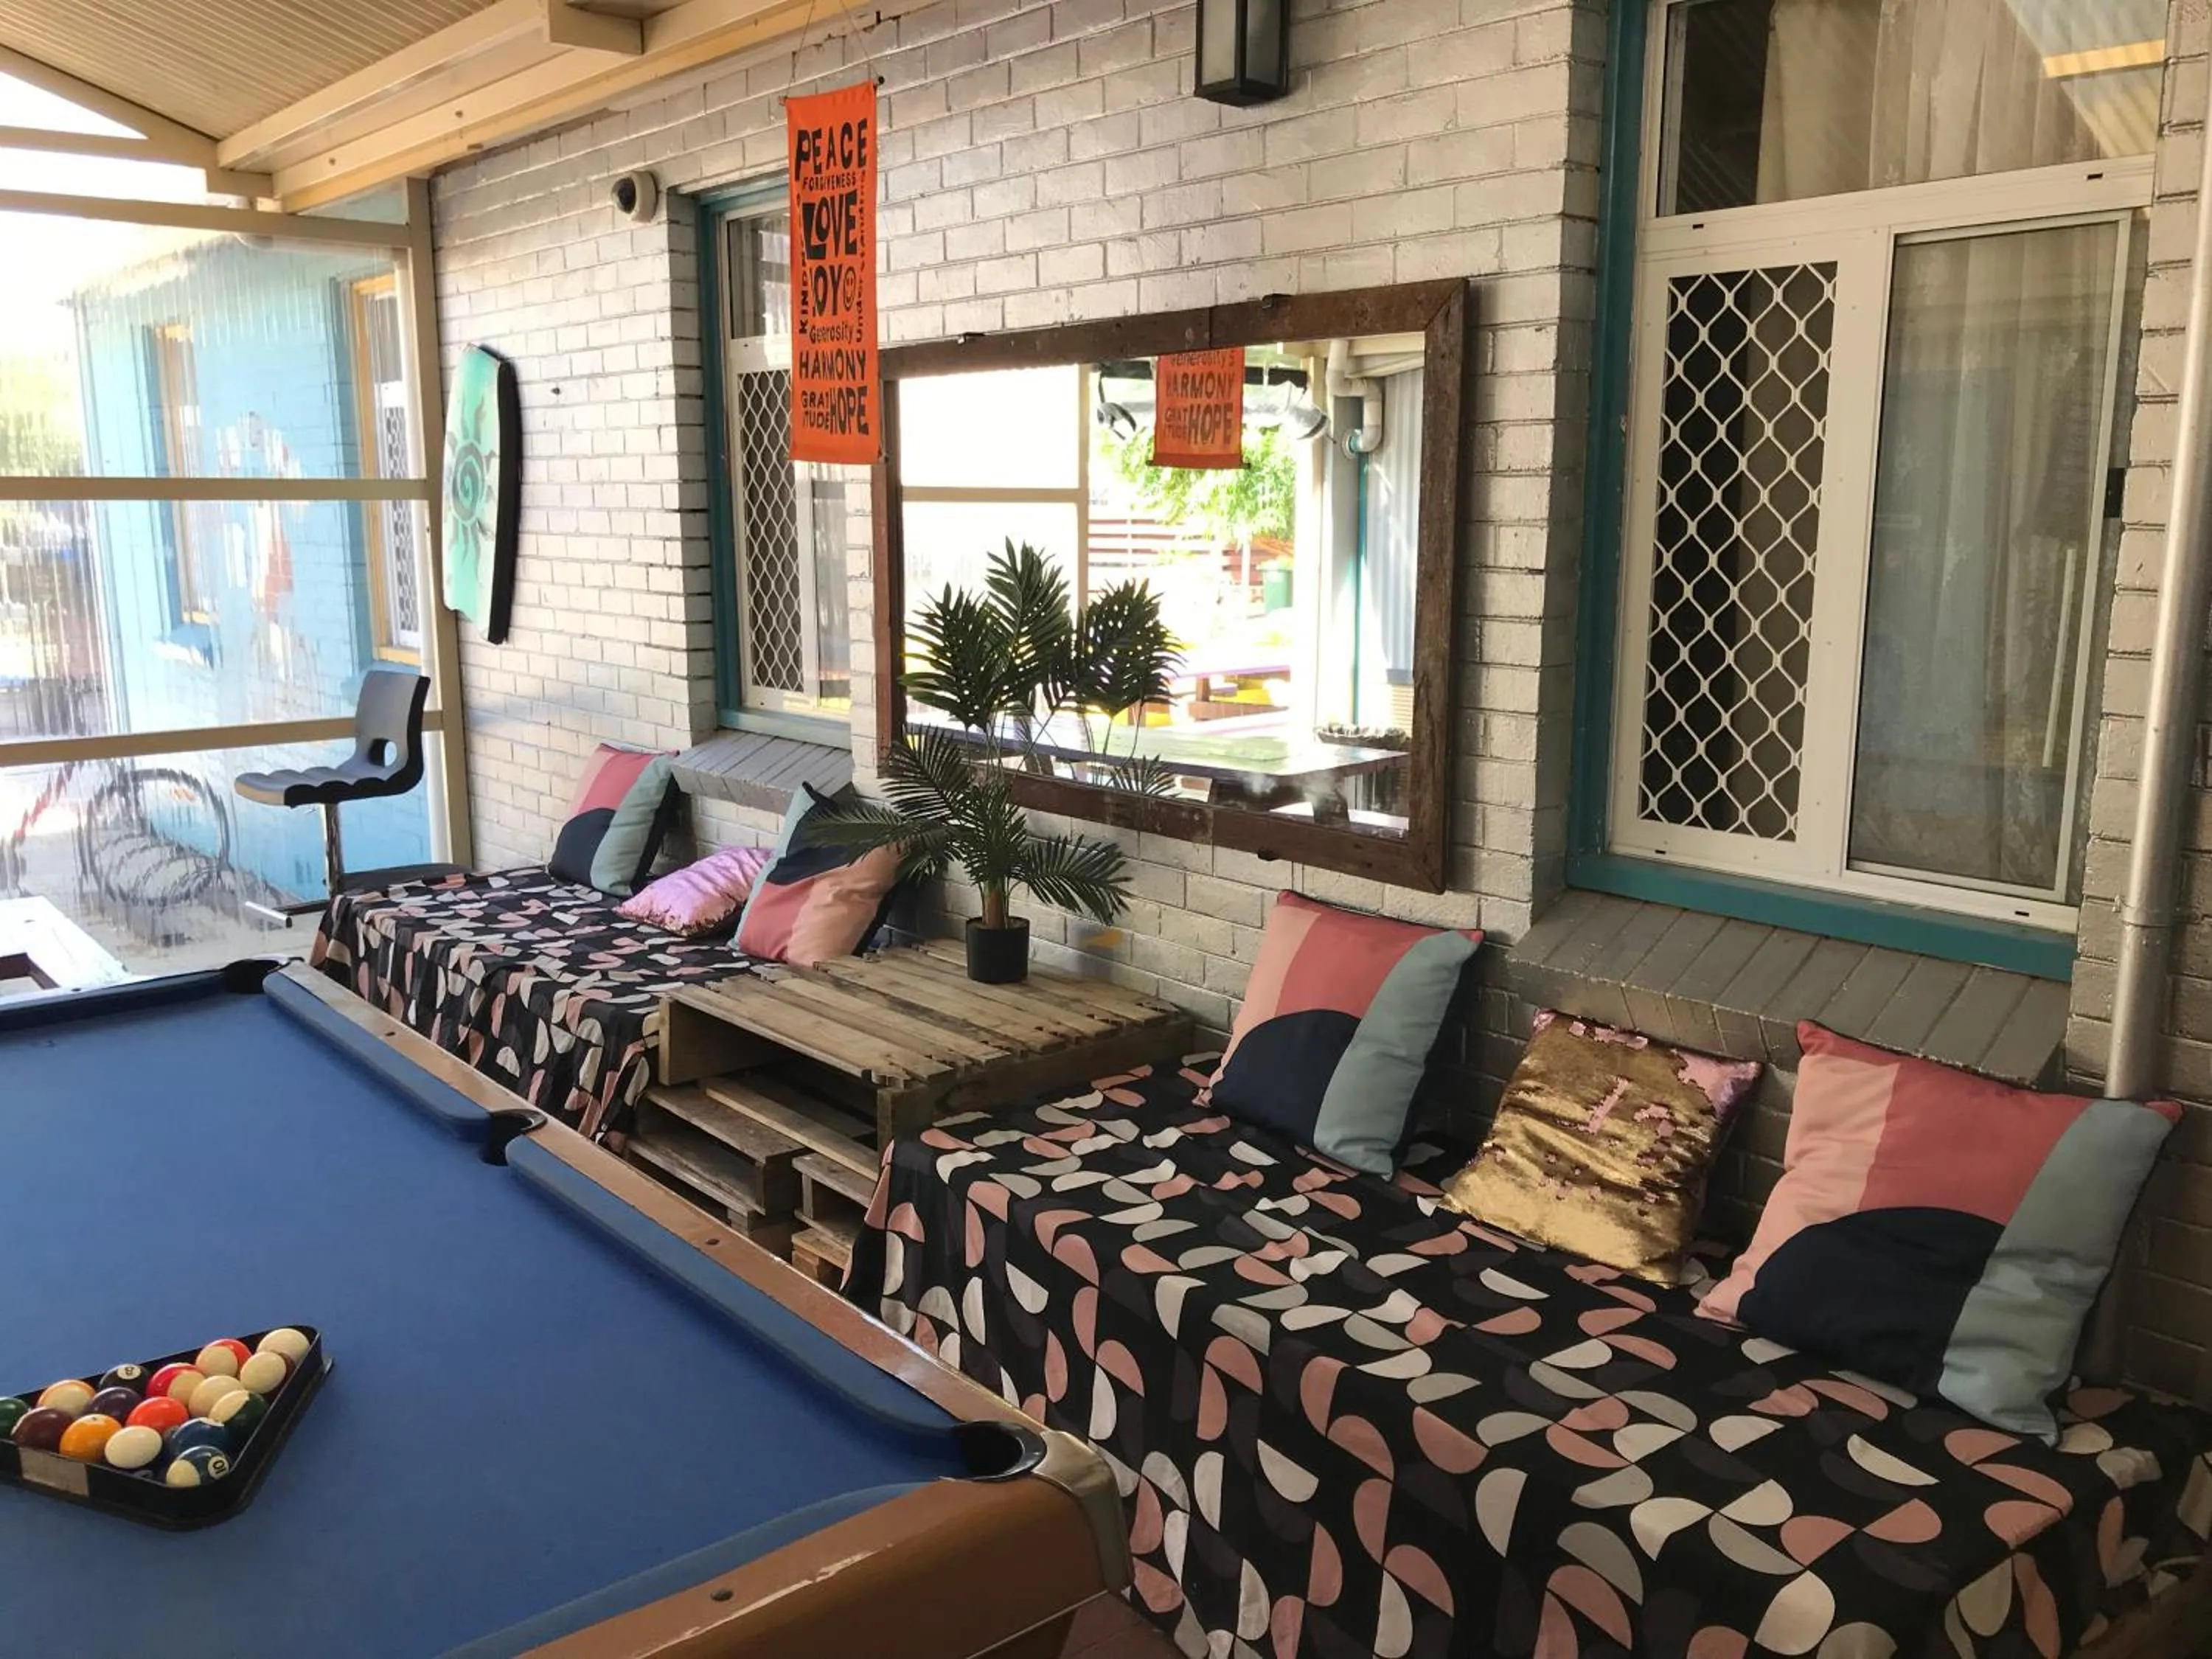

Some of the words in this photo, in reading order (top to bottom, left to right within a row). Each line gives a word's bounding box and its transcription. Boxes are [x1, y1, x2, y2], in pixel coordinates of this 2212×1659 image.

[795, 118, 868, 182] PEACE
[802, 188, 858, 260] LOVE
[829, 386, 869, 435] HOPE
[1188, 402, 1234, 445] HOPE
